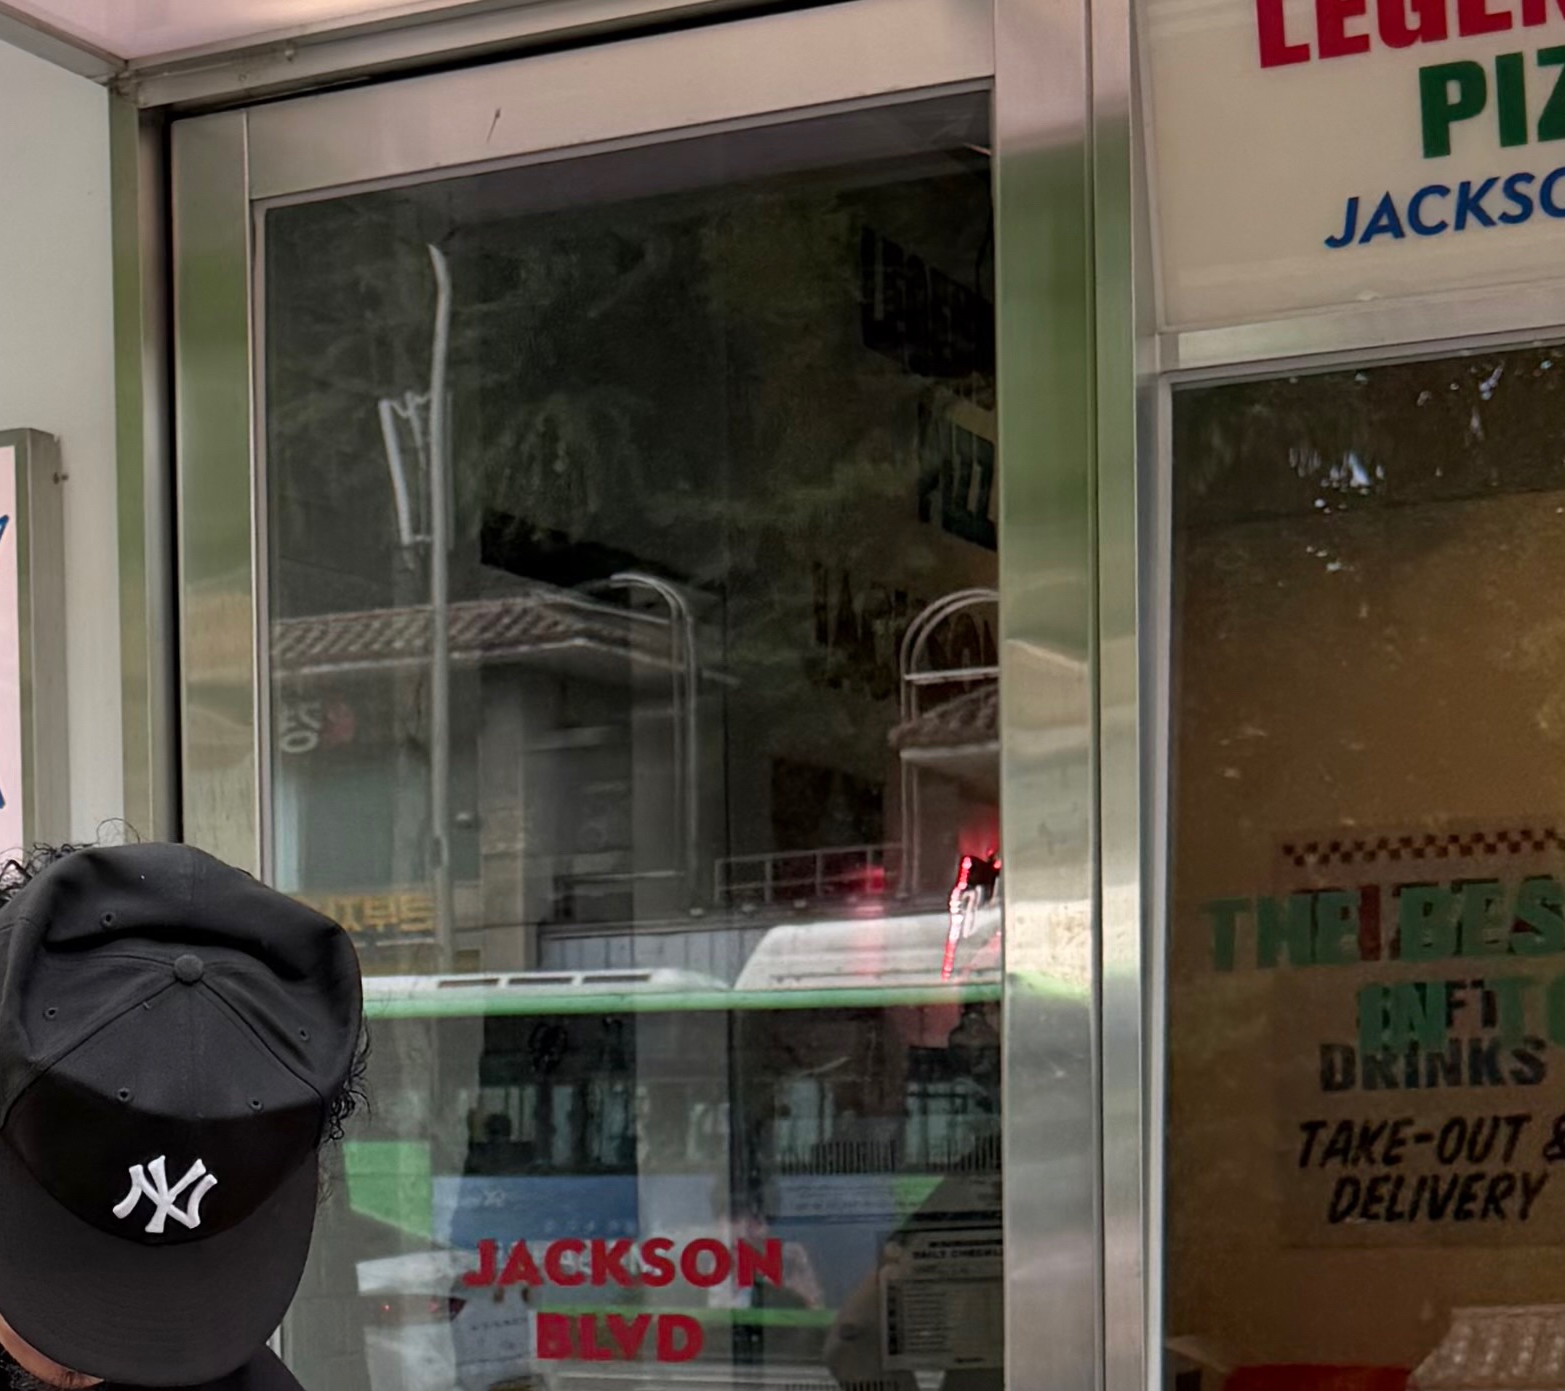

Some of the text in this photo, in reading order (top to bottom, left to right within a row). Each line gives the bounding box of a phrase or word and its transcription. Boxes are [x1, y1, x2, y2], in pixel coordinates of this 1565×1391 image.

[1320, 1034, 1547, 1093] DRINKS
[1299, 1113, 1531, 1168] TAKE-OUT
[112, 1155, 218, 1233] NY
[1327, 1170, 1549, 1223] DELIVERY
[462, 1237, 784, 1290] JACKSON
[537, 1312, 704, 1363] BLVD
